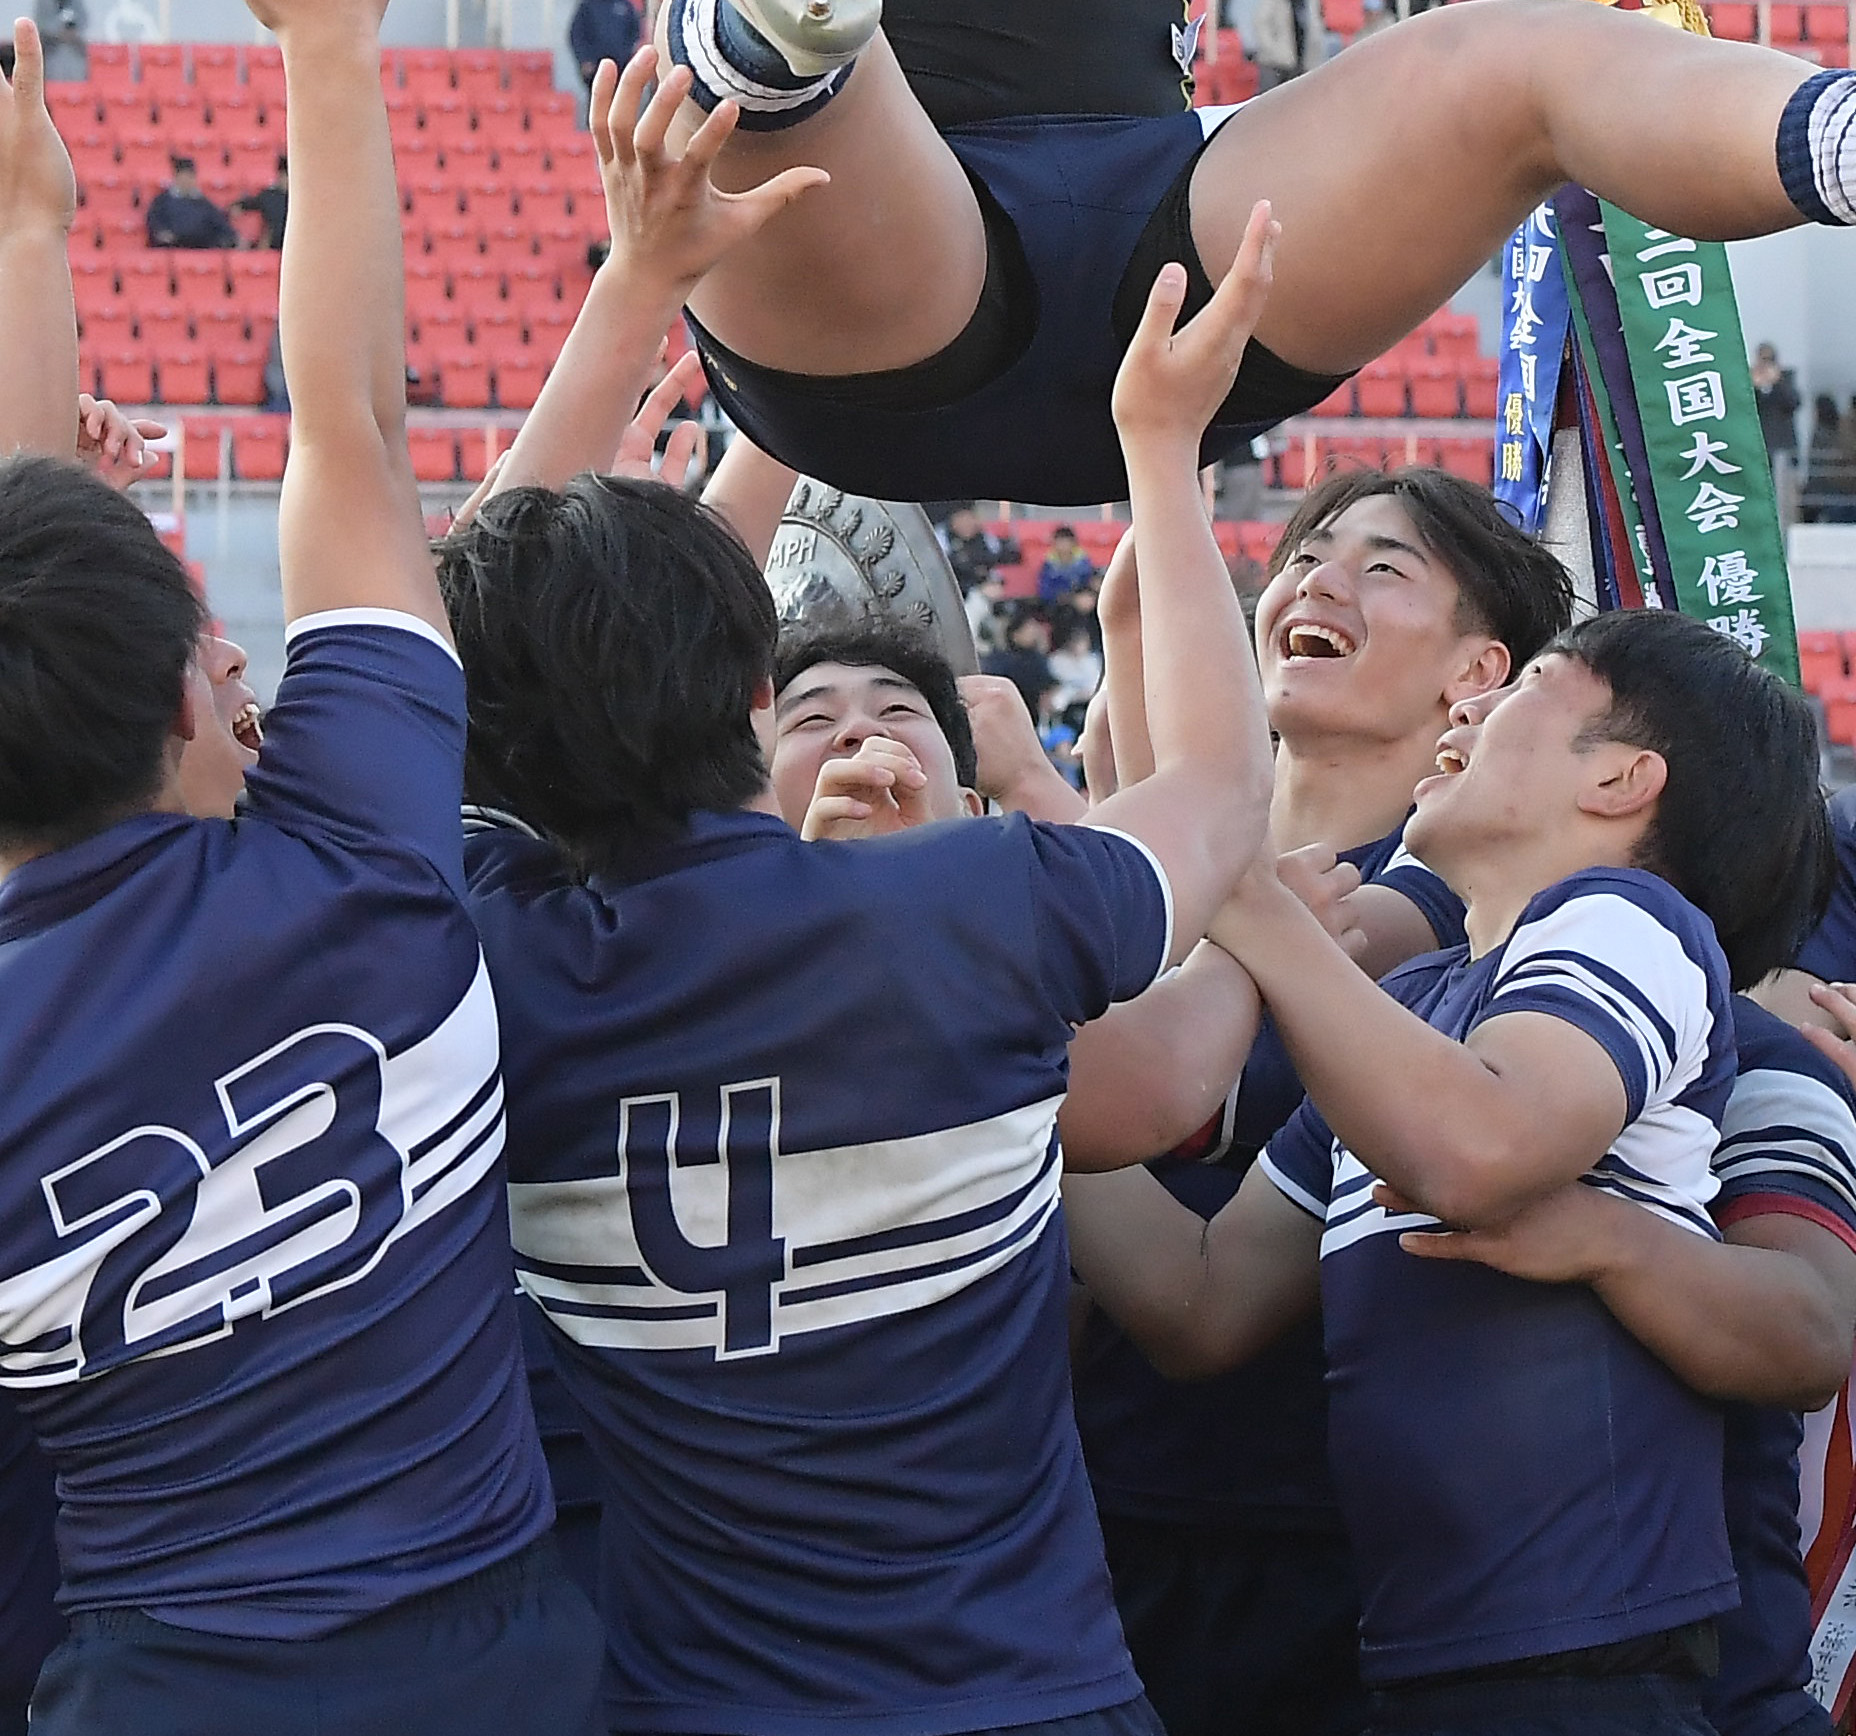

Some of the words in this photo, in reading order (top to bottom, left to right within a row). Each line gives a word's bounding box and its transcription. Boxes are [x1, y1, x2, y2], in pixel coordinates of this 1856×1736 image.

[1696, 550, 1771, 658] 優勝
[40, 1021, 414, 1386] 23
[618, 1076, 787, 1362] 4
